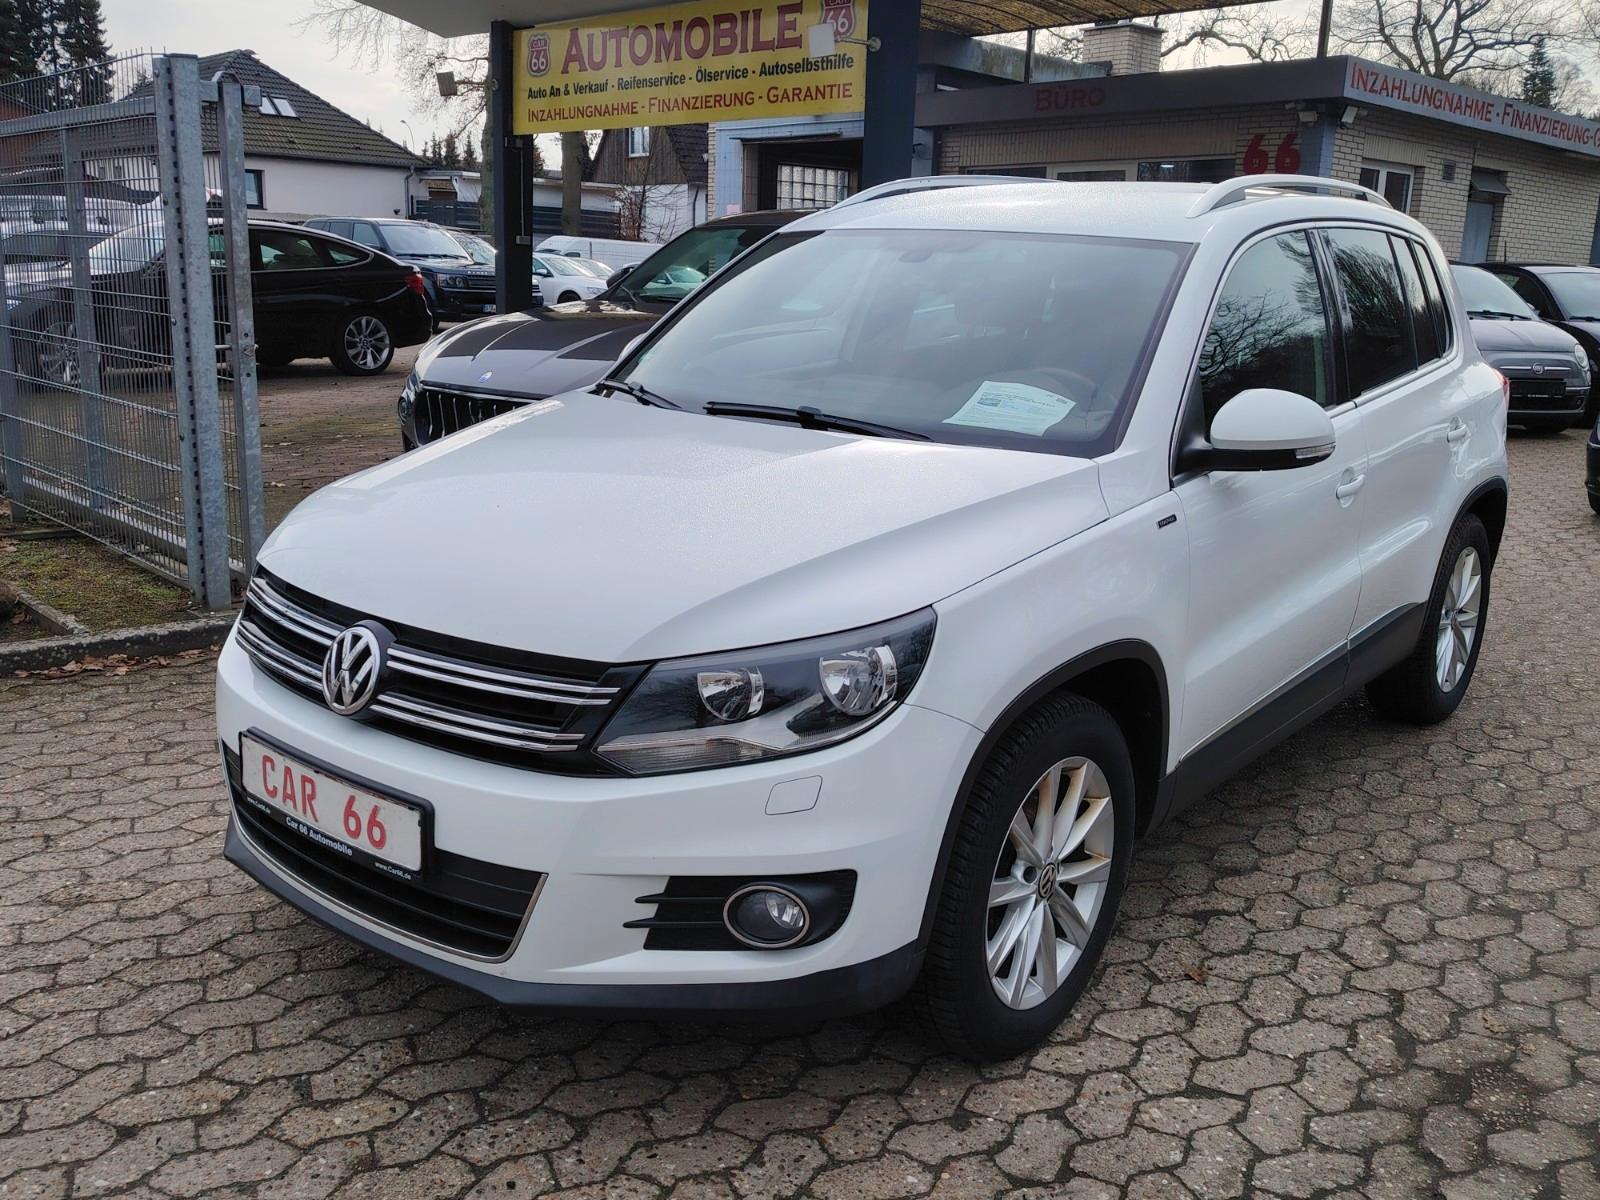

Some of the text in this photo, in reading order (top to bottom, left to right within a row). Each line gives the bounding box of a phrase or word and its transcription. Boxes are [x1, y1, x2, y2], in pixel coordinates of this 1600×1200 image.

[561, 3, 803, 74] AUTOMOBILE
[528, 86, 547, 99] Auto
[549, 85, 561, 97] An
[563, 83, 570, 96] &
[573, 79, 609, 95] Verkauf
[618, 71, 686, 91] Reifenservice
[696, 66, 749, 83] Ölservice
[759, 53, 854, 77] Autoselbsthilfe
[531, 50, 546, 71] 66
[528, 101, 639, 122] INZAHLUNGNAHME
[649, 91, 755, 113] FINANZIERUNG
[766, 83, 853, 104] GARANTIE
[1035, 86, 1105, 112] BÜRO
[1350, 62, 1495, 122] INZAHLUNGNAHME
[1243, 133, 1301, 175] 66
[261, 754, 387, 850] CAR 66
[286, 816, 298, 830] Car
[309, 829, 353, 856] Automobile
